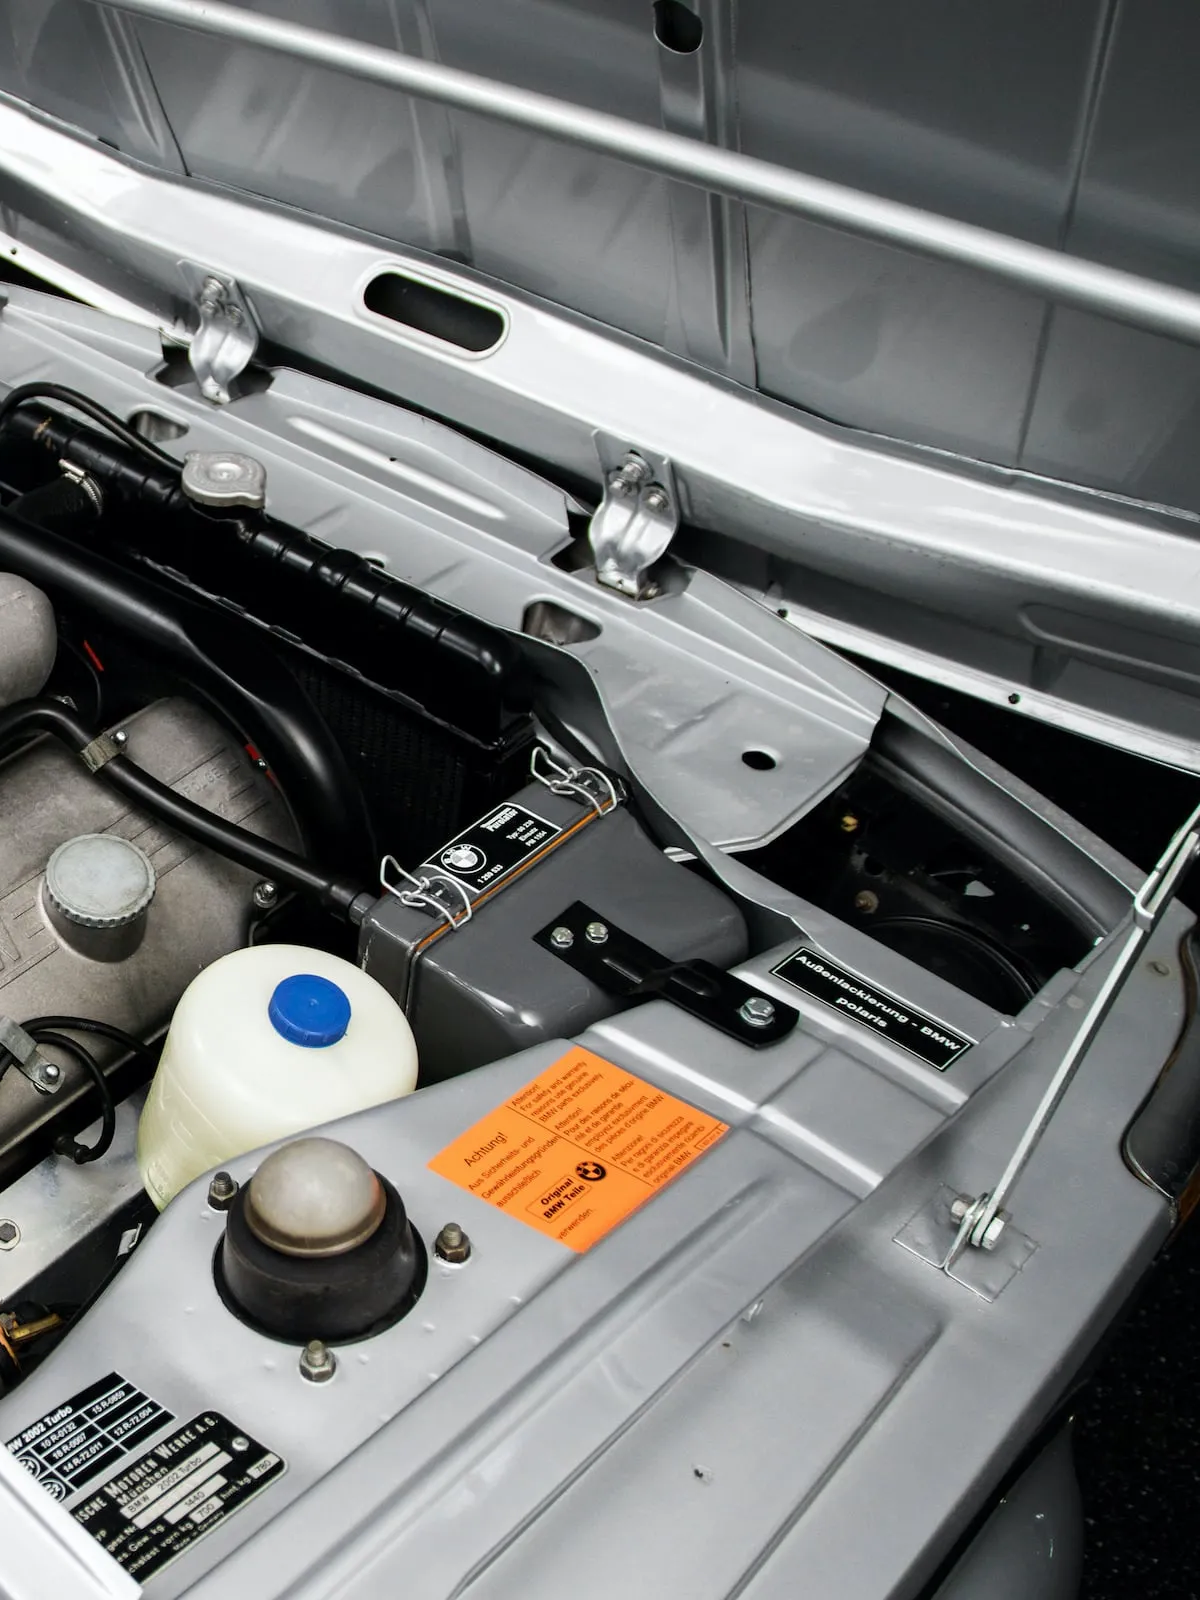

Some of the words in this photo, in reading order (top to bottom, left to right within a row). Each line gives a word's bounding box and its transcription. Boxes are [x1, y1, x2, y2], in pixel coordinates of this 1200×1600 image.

[795, 954, 909, 1024] Außenlackierung
[920, 1026, 960, 1051] BMW
[835, 996, 887, 1028] polaris
[549, 1078, 563, 1089] and
[560, 1061, 586, 1080] warranty
[554, 1089, 566, 1098] use
[564, 1071, 588, 1090] genuine
[538, 1107, 557, 1122] BMW
[556, 1096, 573, 1110] parts
[645, 1094, 664, 1109] BMW
[562, 1123, 580, 1136] Pour
[464, 1131, 507, 1166] Achtung!
[619, 1156, 633, 1166] Per
[672, 1150, 691, 1165] BMW
[468, 1178, 484, 1190] Aus
[481, 1149, 519, 1178] Sicherheits-
[520, 1135, 535, 1148] und
[481, 1135, 560, 1198] Gewährleistungsgründen
[496, 1169, 540, 1206] ausschließlich
[540, 1178, 573, 1205] Original
[543, 1199, 564, 1218] BMW
[562, 1185, 585, 1200] Teile
[22, 1422, 45, 1442] 2002
[43, 1406, 72, 1425] Turbo
[113, 1426, 124, 1436] 12
[195, 1417, 217, 1433] A.G.
[40, 1438, 51, 1448] 10
[116, 1467, 170, 1505] München
[127, 1495, 149, 1512] BMW
[157, 1472, 180, 1490] 2002
[178, 1457, 201, 1473] Turbo
[160, 1531, 179, 1547] vorn
